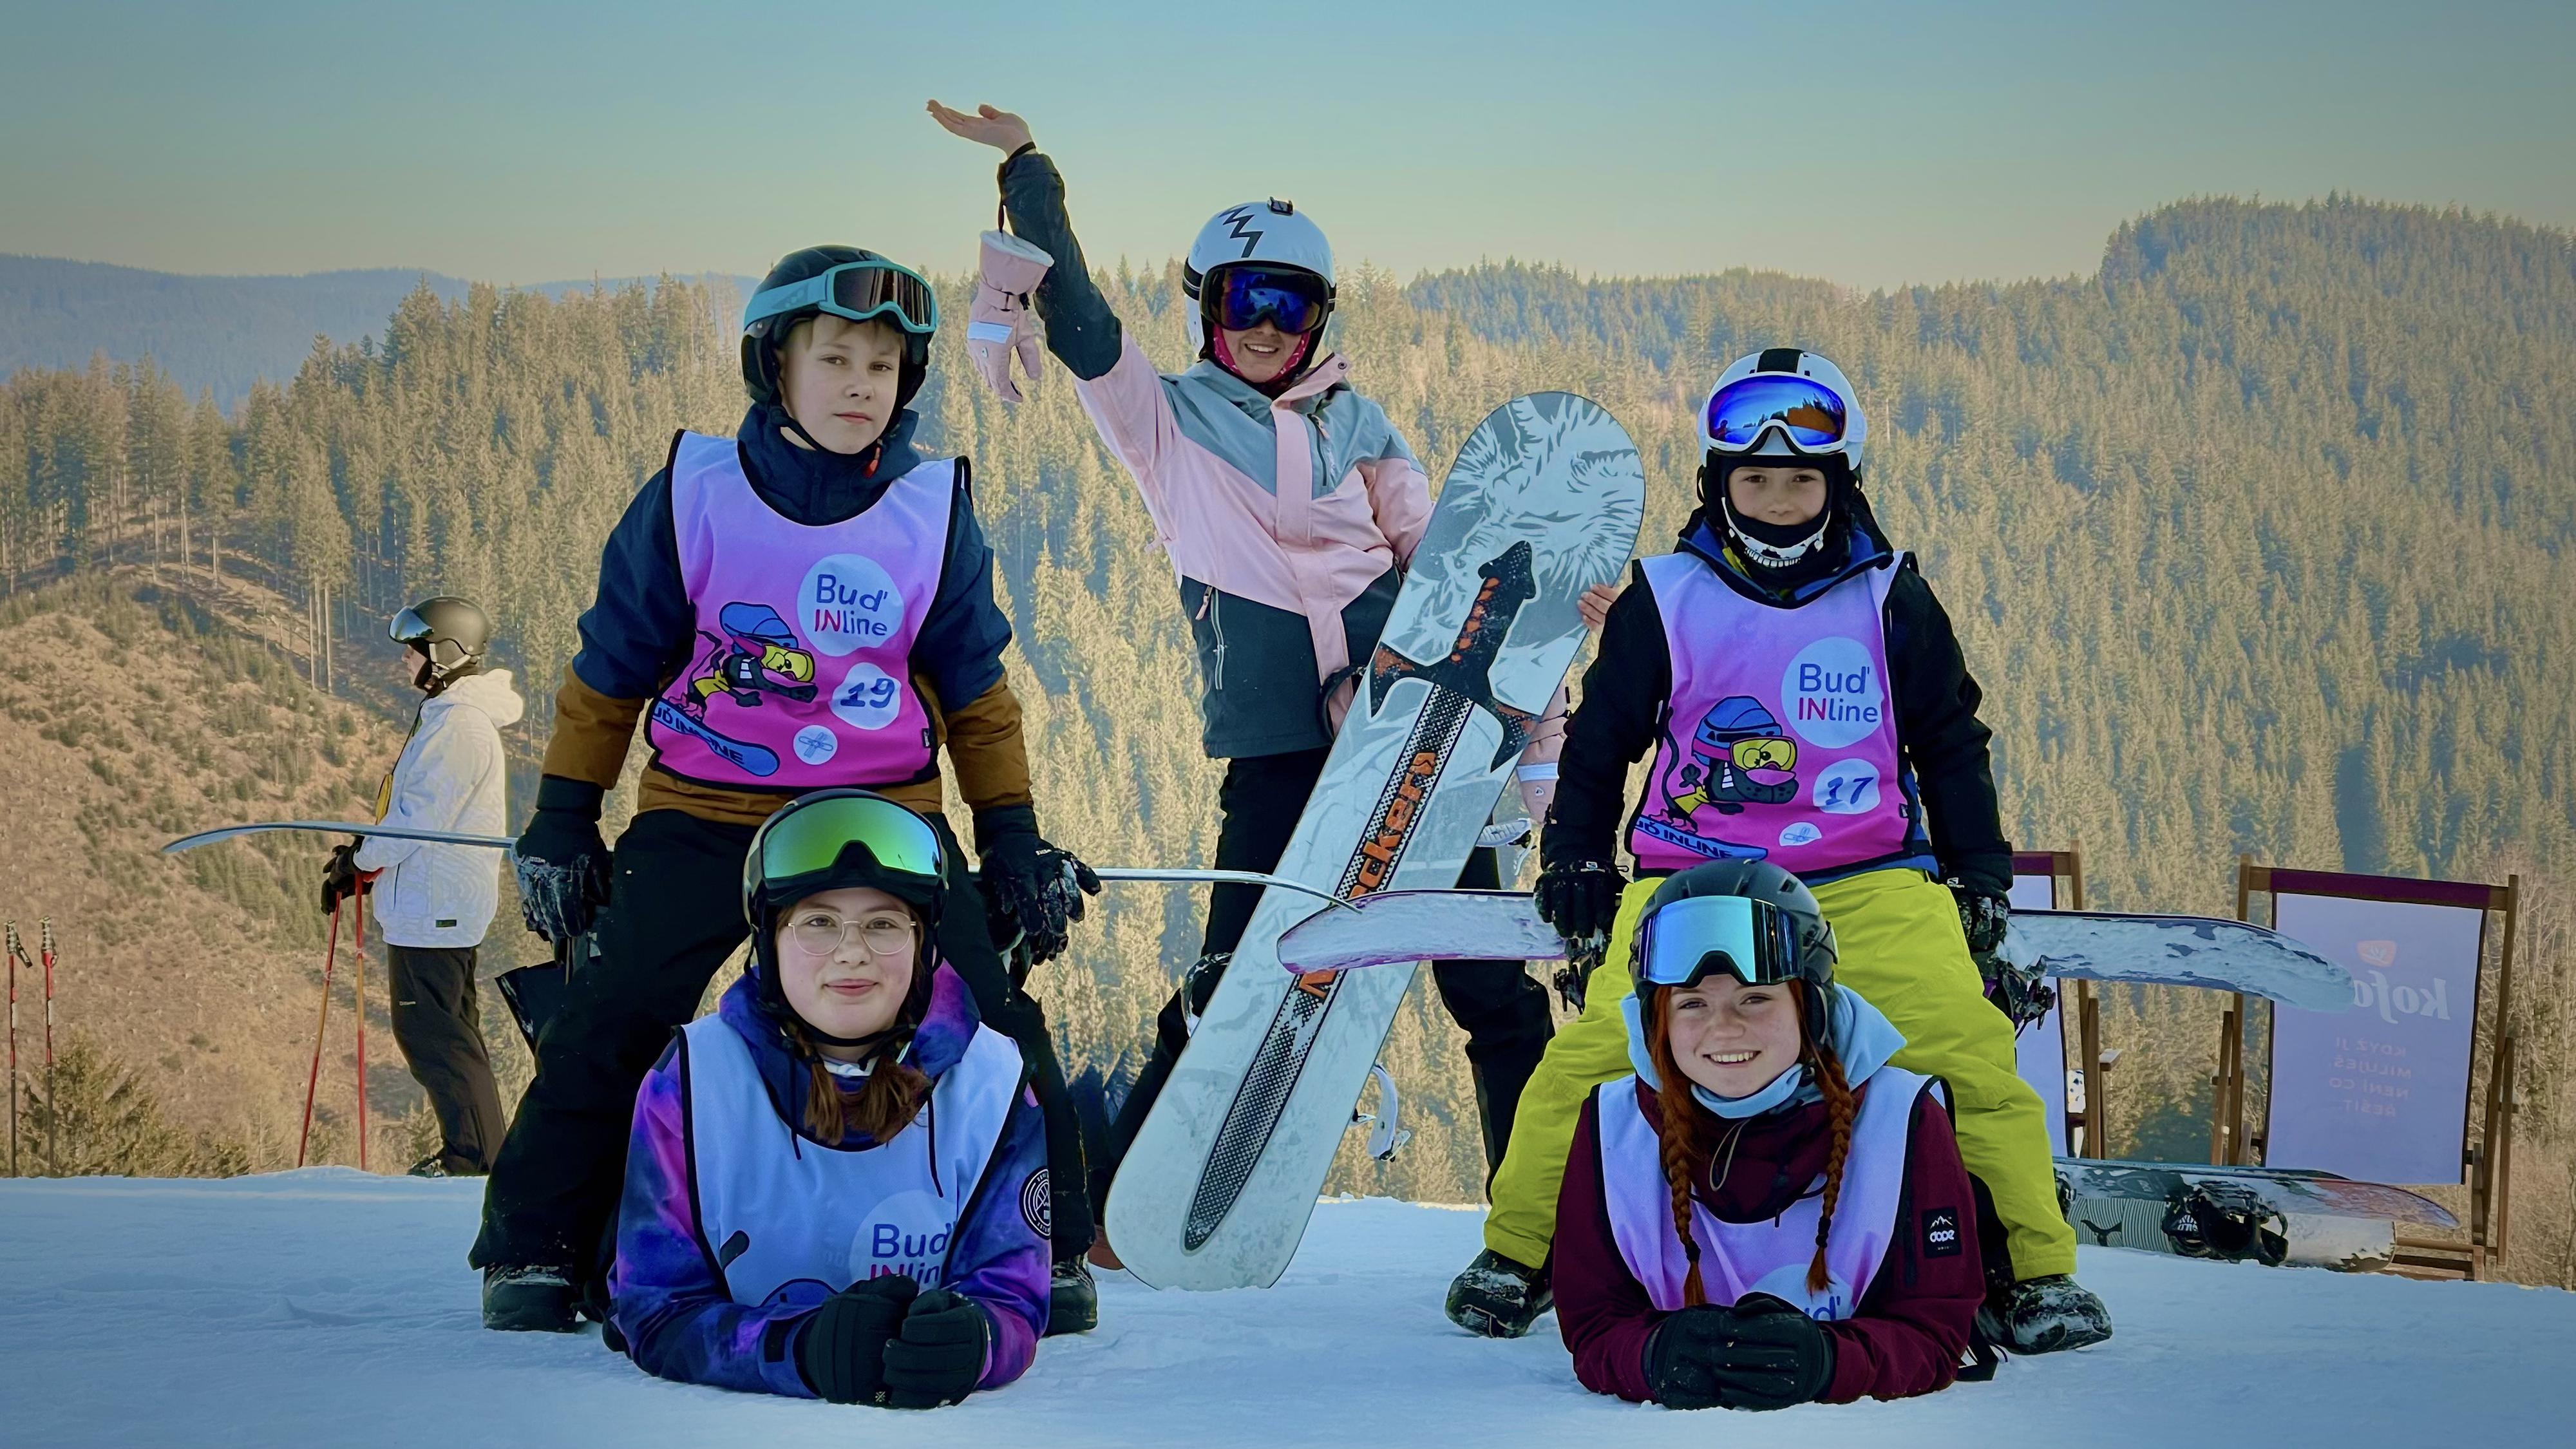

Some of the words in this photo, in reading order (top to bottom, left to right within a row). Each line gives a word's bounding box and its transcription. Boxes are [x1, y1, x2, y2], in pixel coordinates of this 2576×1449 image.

[814, 609, 888, 636] INline
[840, 678, 895, 709] 19
[1798, 697, 1879, 723] INline
[1825, 777, 1874, 805] 17
[1929, 1229, 1955, 1243] dope
